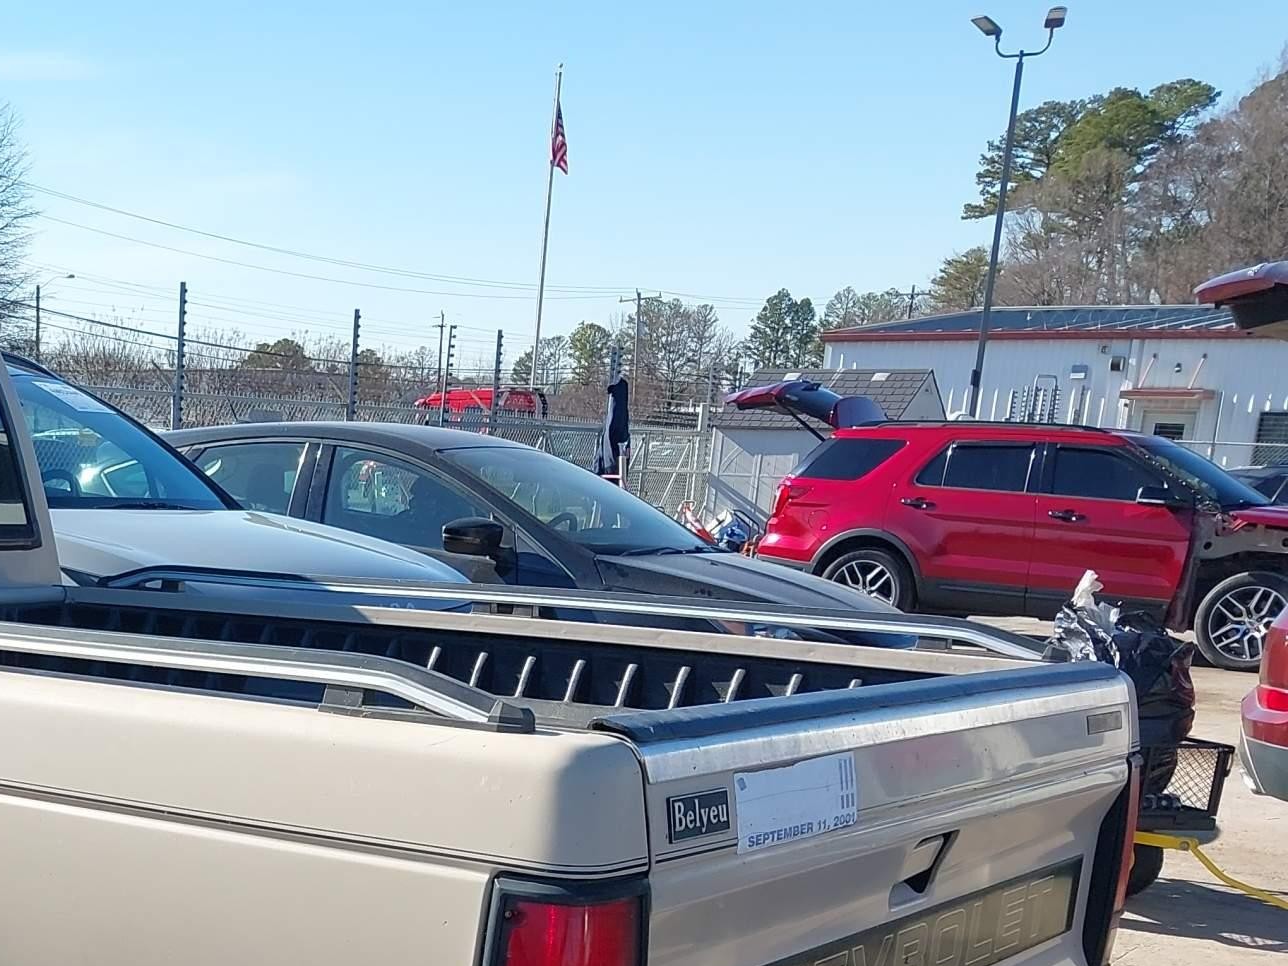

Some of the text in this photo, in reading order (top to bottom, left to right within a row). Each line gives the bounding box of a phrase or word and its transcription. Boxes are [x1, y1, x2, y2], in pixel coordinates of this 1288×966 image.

[674, 797, 728, 833] Belyeu
[747, 811, 857, 848] SEPTEMBER 11, 2001
